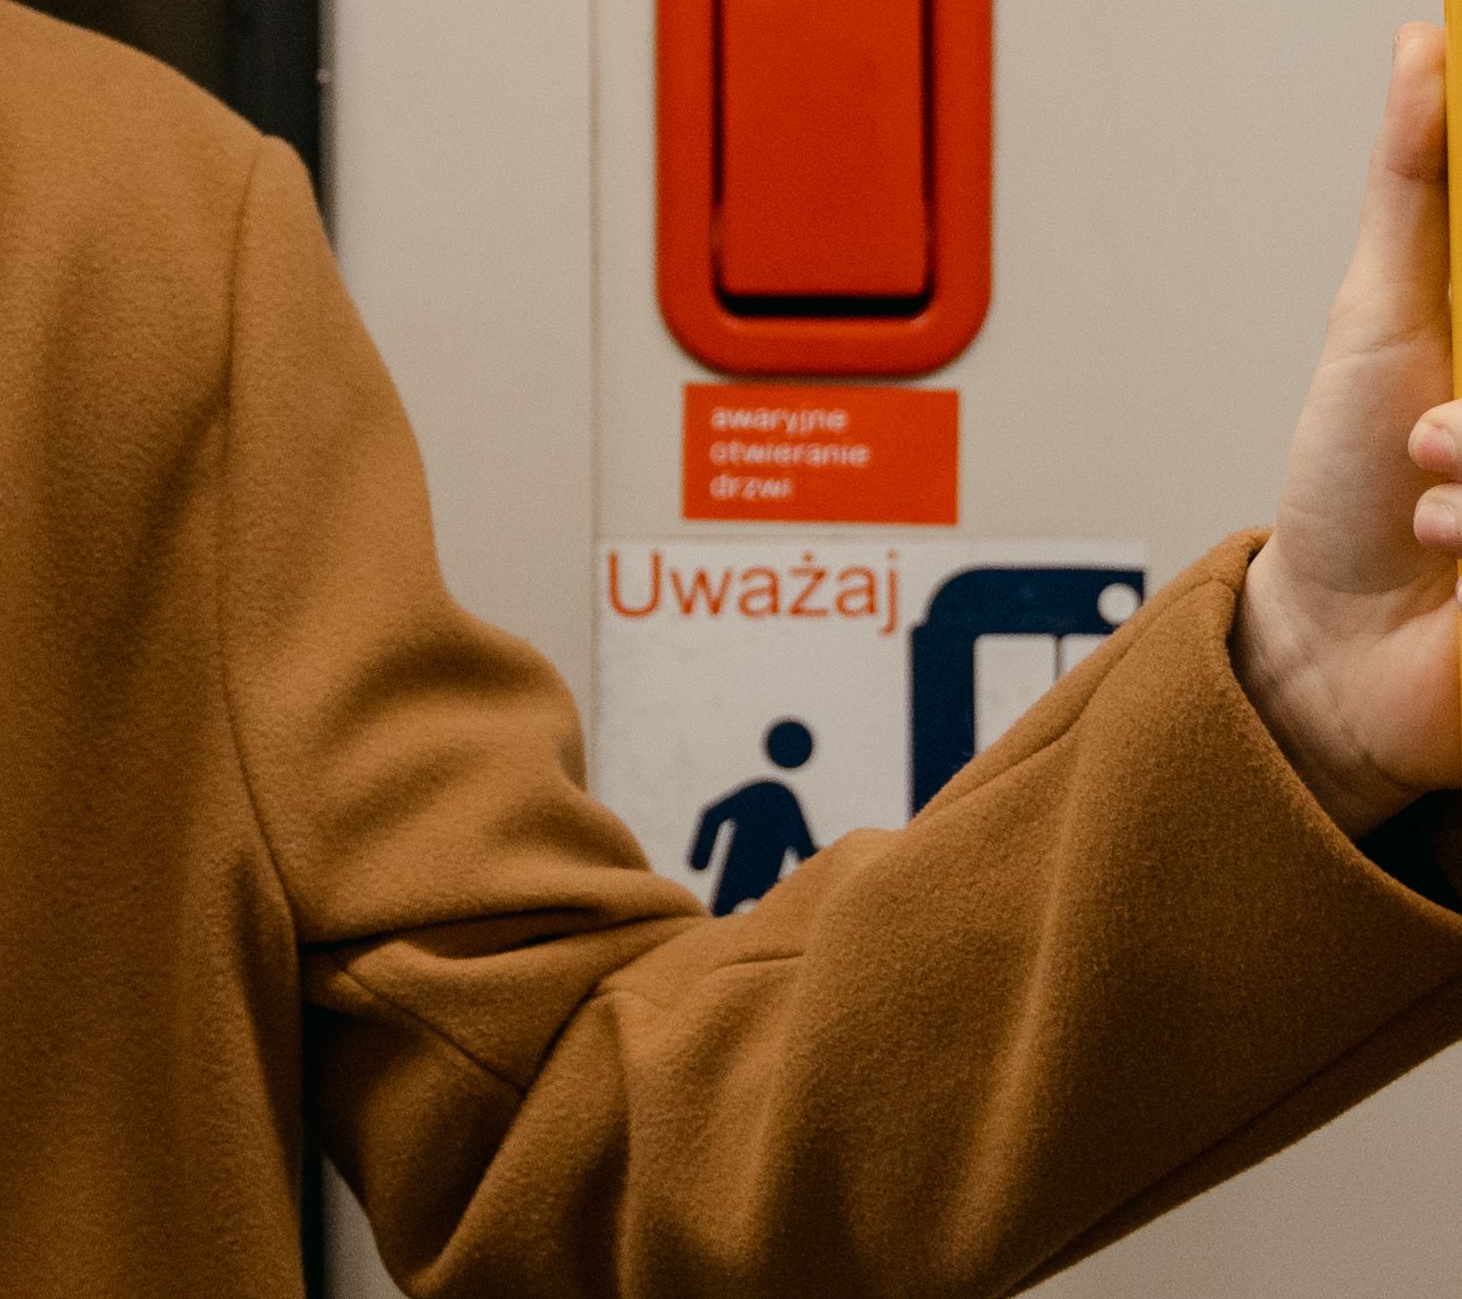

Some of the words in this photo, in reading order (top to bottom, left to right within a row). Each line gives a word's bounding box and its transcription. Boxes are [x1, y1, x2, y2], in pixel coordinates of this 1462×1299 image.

[711, 407, 848, 436] awaryjne
[709, 440, 872, 467] otwieranie
[709, 473, 794, 500] drzwi
[607, 549, 900, 637] Uważaj
